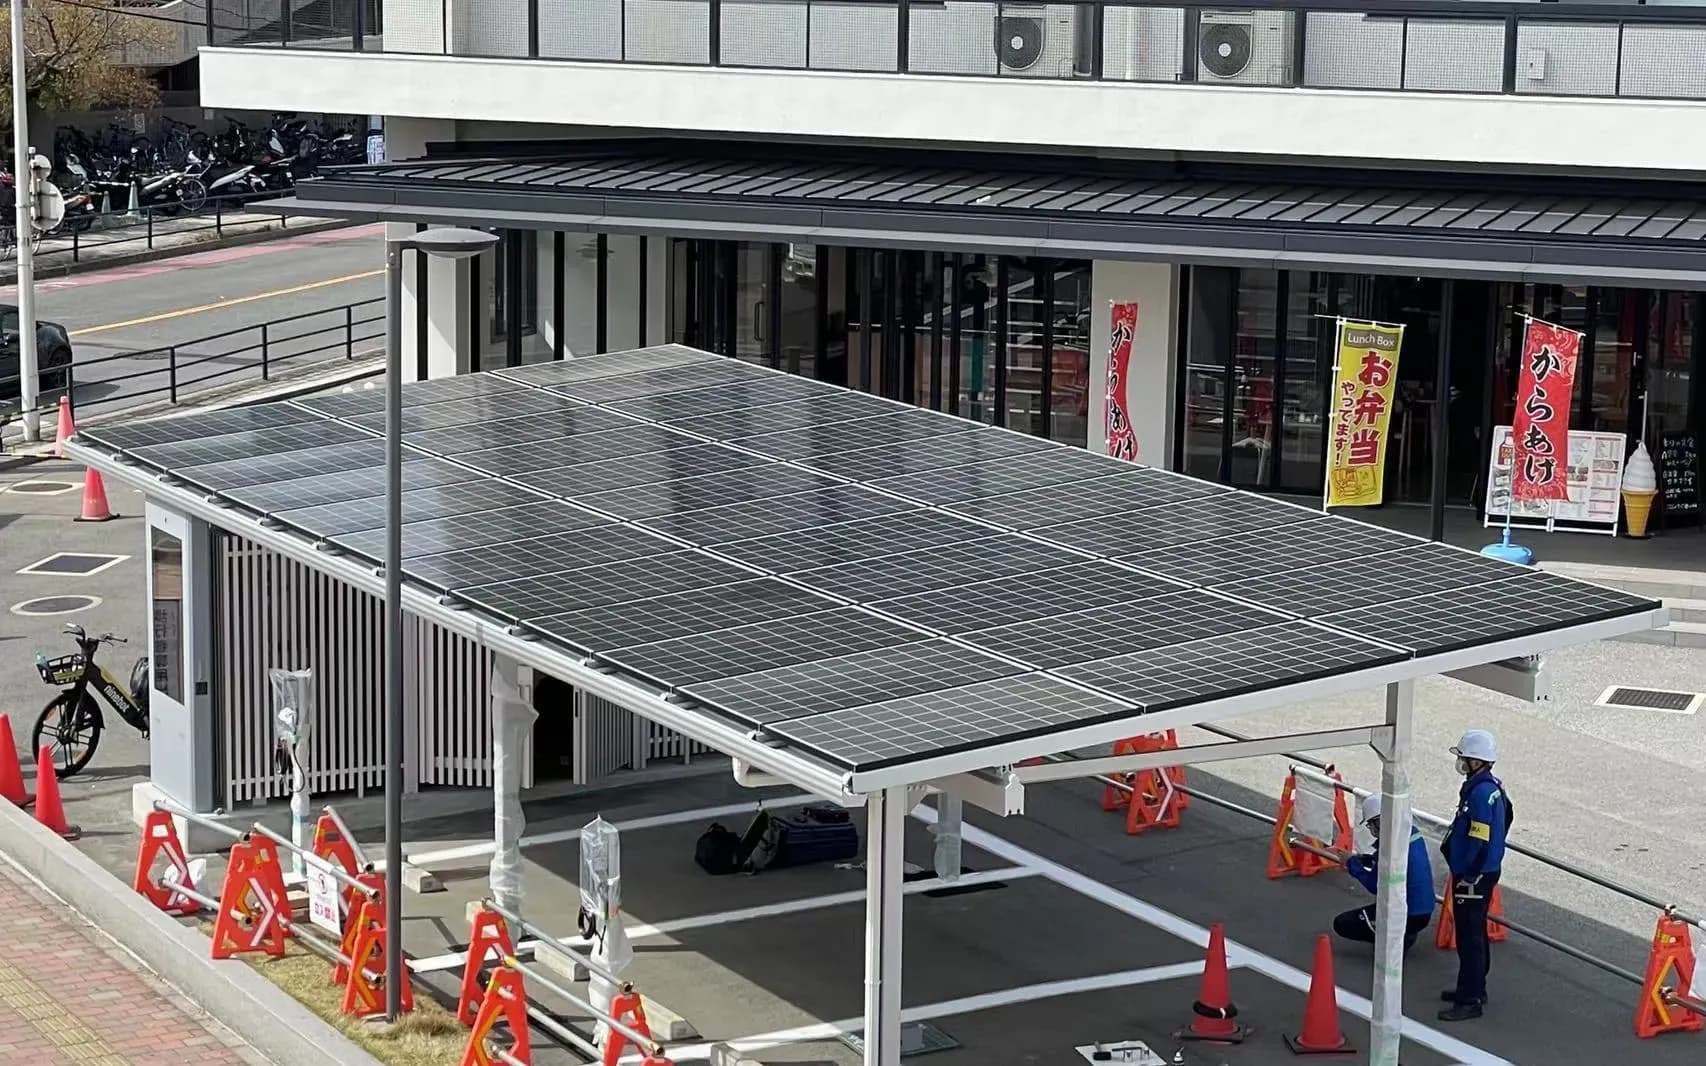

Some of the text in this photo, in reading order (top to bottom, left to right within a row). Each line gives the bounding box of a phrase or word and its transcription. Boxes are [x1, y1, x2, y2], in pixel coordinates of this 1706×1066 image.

[1347, 333, 1395, 347] Lunch Box
[1334, 381, 1356, 466] やってます!
[1348, 351, 1393, 467] お弁当
[1524, 344, 1561, 485] からあげ
